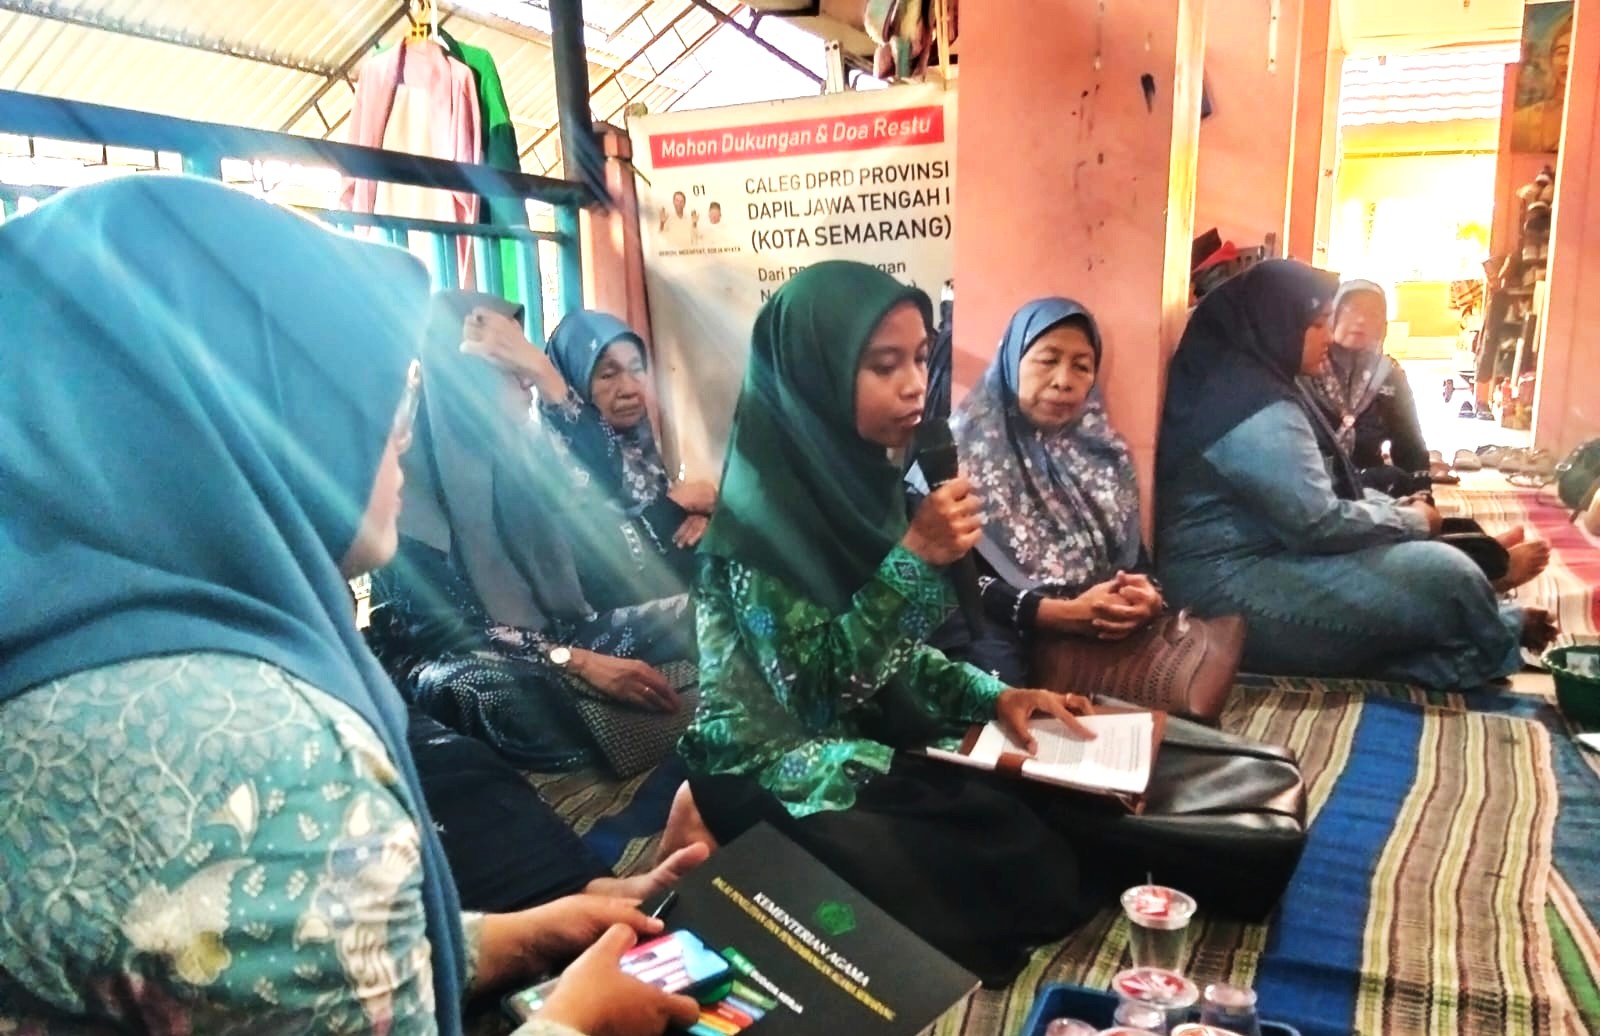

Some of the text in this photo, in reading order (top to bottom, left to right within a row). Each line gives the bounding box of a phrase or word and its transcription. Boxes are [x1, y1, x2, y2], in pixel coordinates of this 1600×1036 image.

[661, 115, 931, 158] Mohon Dukungan & Doa Restu
[692, 184, 706, 197] 01
[745, 160, 949, 195] CALEG DPRD PROVINSI
[747, 186, 950, 221] DAPIL JAWA TENGAH I
[751, 214, 952, 254] (KOTA SEMARANG)
[758, 265, 785, 283] Dari
[753, 891, 831, 957] KEMENTERIAN
[826, 951, 870, 987] AGAMA
